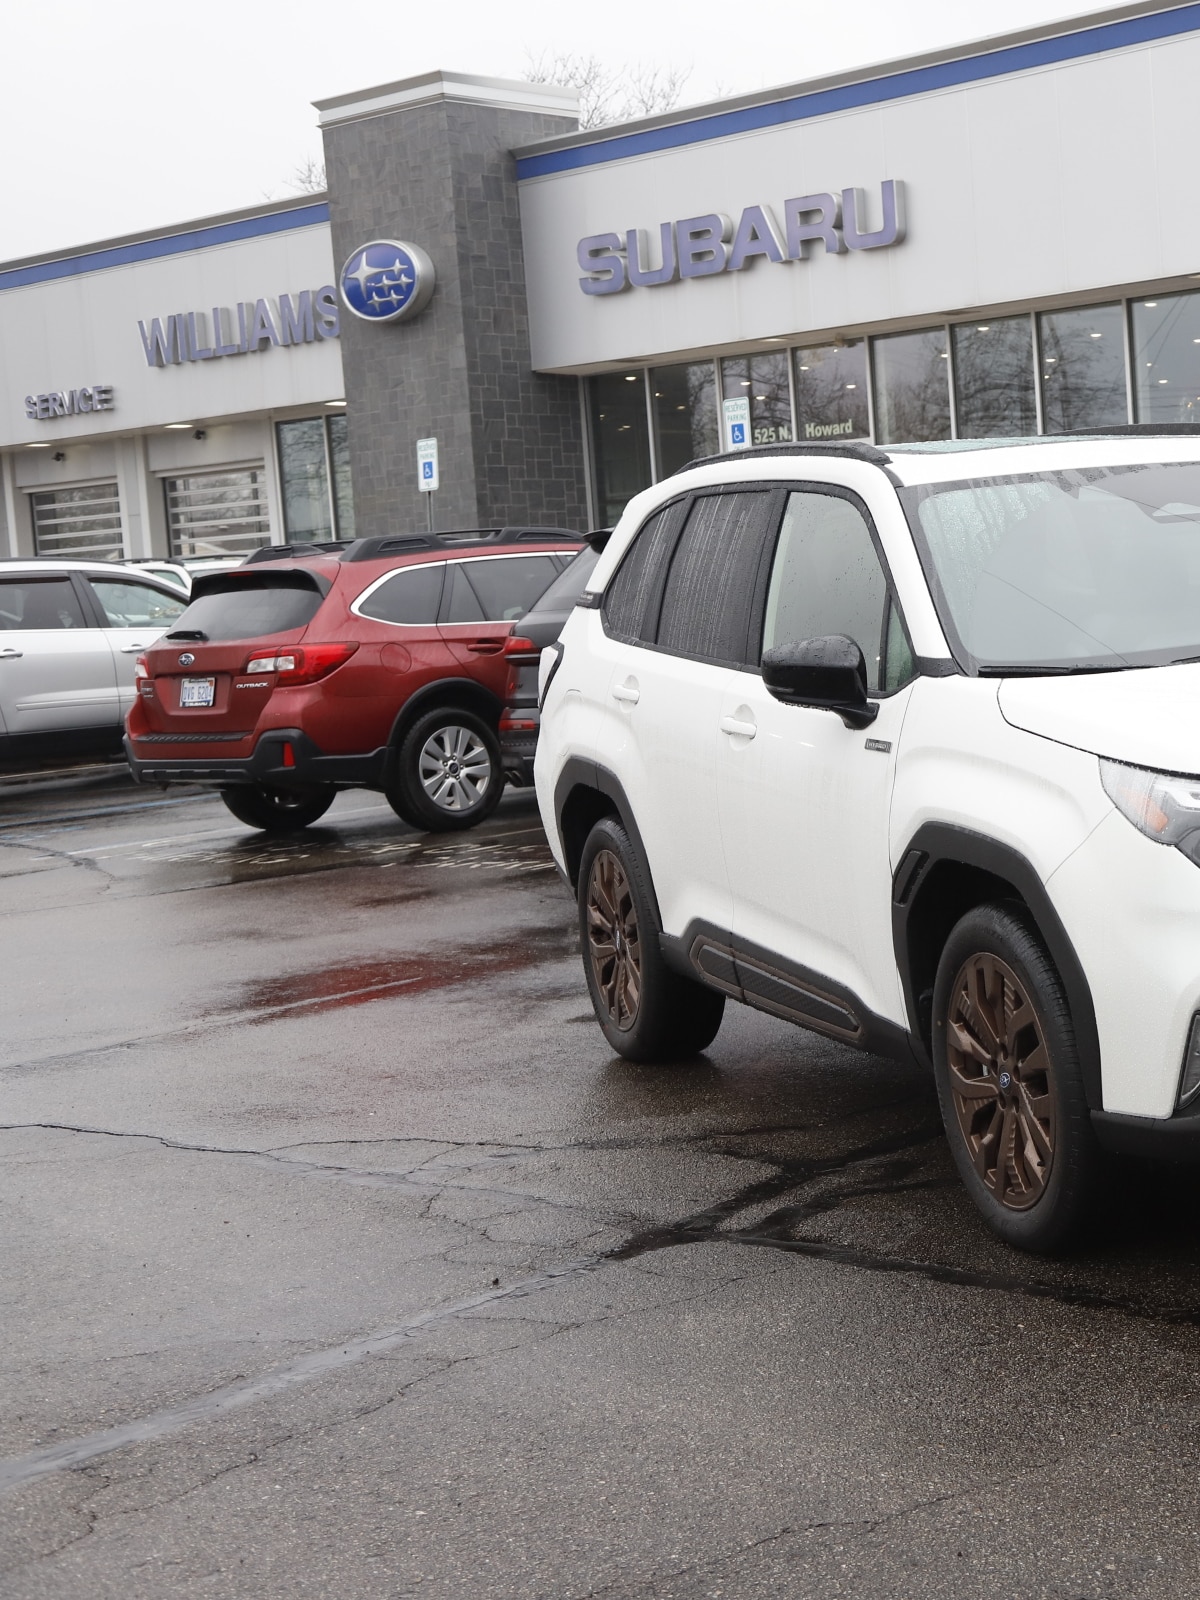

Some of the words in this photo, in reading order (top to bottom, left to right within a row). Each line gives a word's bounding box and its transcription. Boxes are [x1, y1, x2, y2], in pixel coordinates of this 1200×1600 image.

[577, 179, 904, 295] SUBARU
[137, 285, 340, 367] WILLIAMS
[24, 385, 114, 420] SERVICE
[754, 427, 776, 443] 525
[779, 425, 792, 441] N.
[805, 419, 853, 438] Howard
